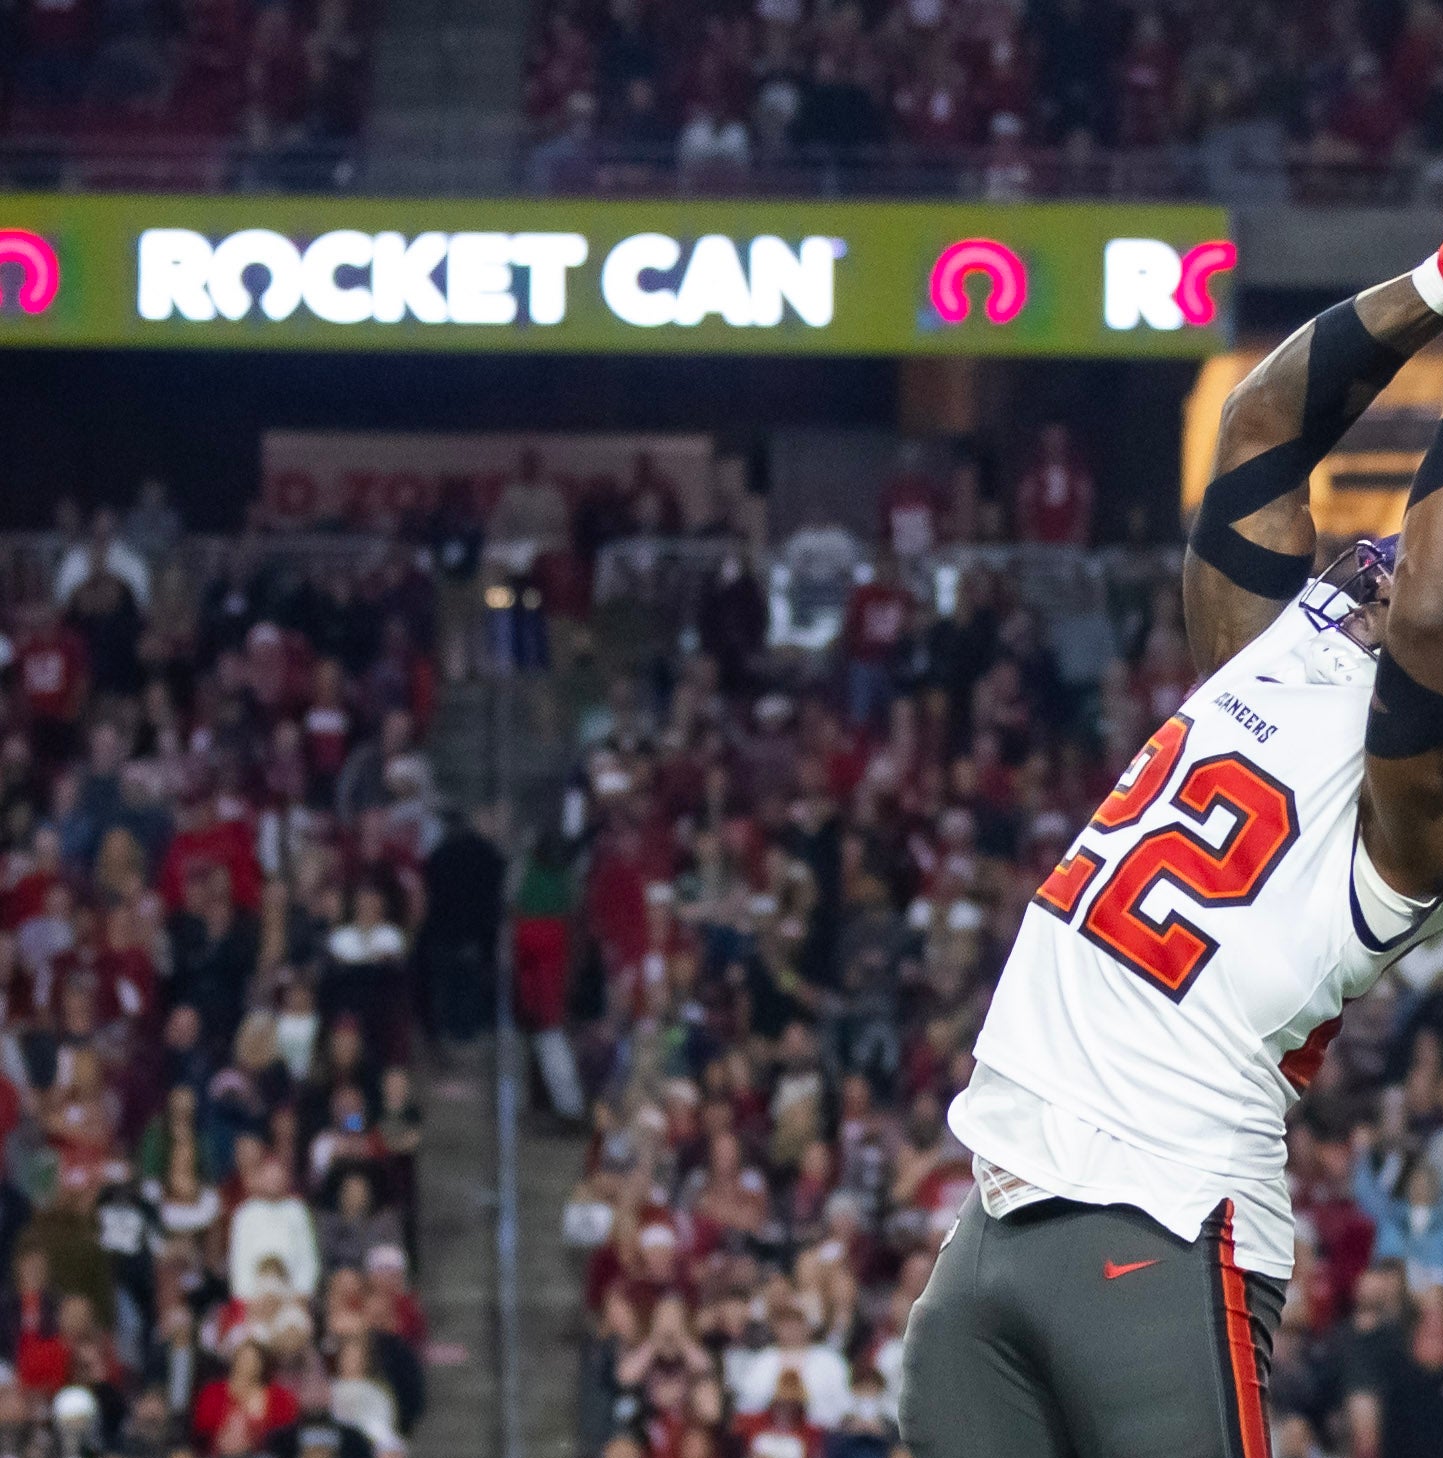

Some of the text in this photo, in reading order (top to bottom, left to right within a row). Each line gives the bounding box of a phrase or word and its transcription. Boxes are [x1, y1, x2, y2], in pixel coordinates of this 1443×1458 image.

[137, 228, 835, 328] ROCKET CAN
[1030, 711, 1301, 1006] 22
